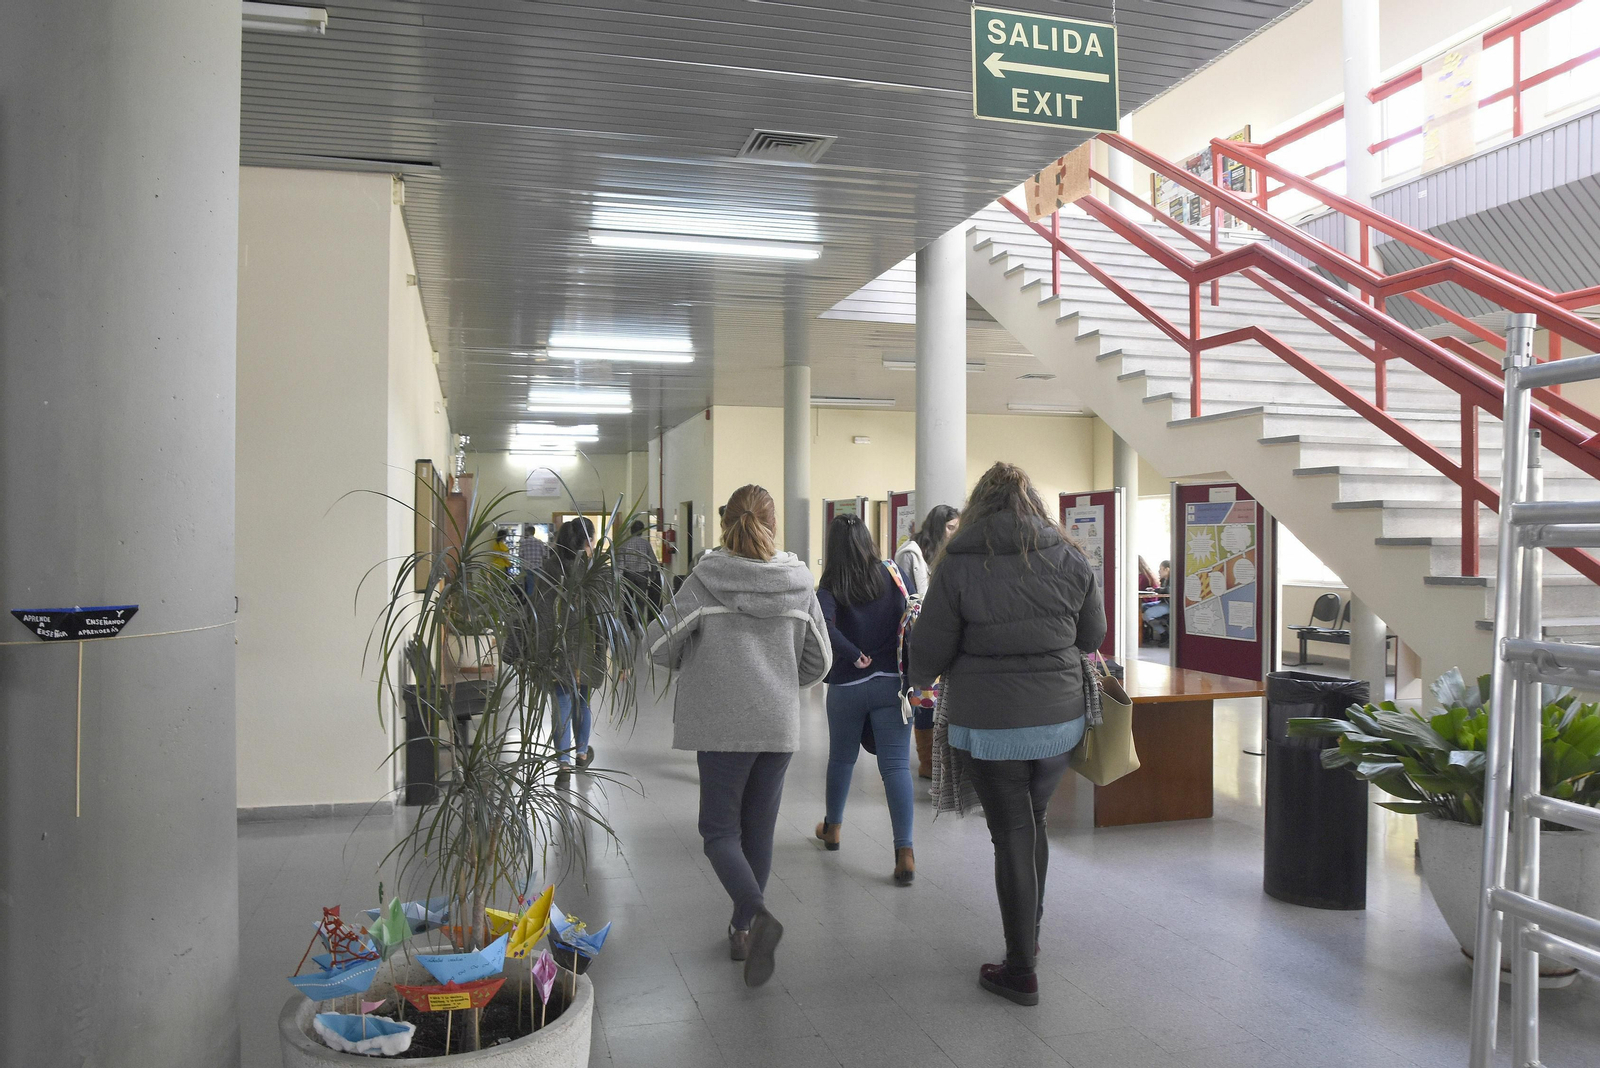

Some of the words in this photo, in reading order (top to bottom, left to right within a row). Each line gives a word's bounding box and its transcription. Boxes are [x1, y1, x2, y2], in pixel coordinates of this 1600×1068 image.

[987, 19, 1104, 58] SALIDA
[1012, 88, 1084, 119] EXIT
[23, 614, 51, 623] APRENDE
[116, 610, 124, 618] Y
[85, 616, 126, 626] ENSEÑANDO
[78, 626, 119, 636] APRENDERÁS
